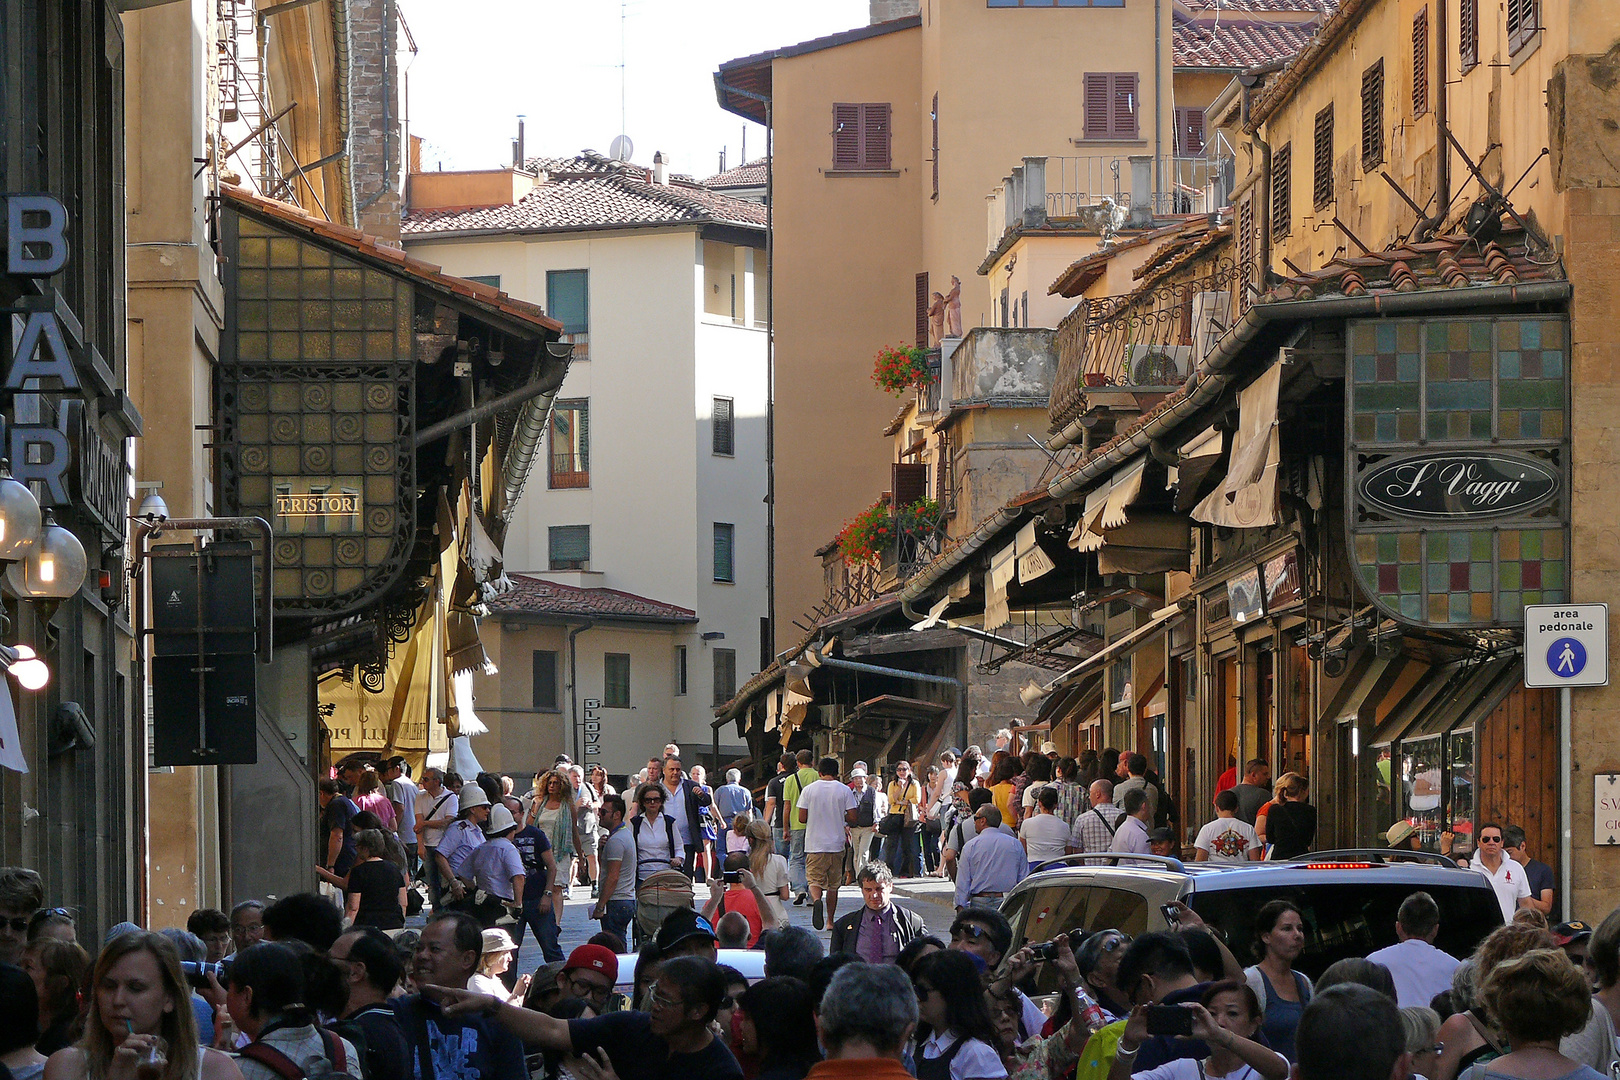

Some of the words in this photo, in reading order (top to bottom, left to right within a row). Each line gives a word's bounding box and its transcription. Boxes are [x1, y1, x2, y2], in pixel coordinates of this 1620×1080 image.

[7, 195, 82, 506] BAR
[1386, 462, 1438, 498] S.
[1439, 463, 1525, 506] Vaggi
[276, 497, 360, 512] T.RISTORI
[1539, 621, 1594, 633] pedonale
[1553, 610, 1579, 619] area
[583, 698, 601, 755] GLOVE
